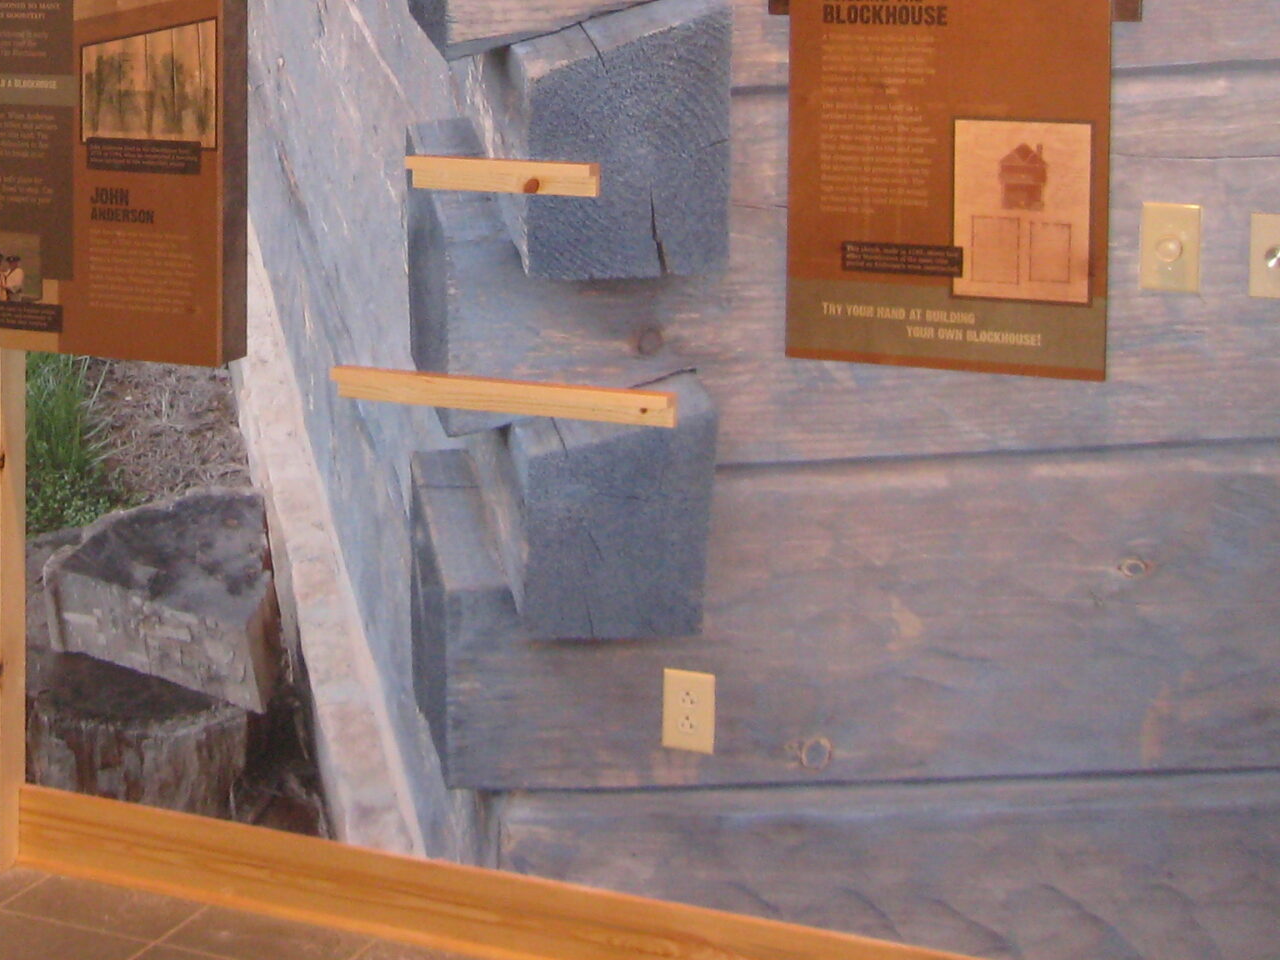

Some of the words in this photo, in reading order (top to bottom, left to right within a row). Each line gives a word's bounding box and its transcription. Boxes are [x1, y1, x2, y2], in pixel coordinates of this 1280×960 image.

[823, 3, 948, 26] BLOCKHOUSE
[91, 186, 130, 207] JOHN
[91, 207, 155, 225] ANDERSON
[822, 301, 843, 315] TRY
[846, 303, 875, 319] YOUR
[908, 308, 923, 321] AT
[925, 309, 976, 325] BUILDING
[906, 325, 936, 340] YOUR
[937, 327, 964, 341] OWN
[966, 329, 1042, 347] BLOCKHOUSE!
